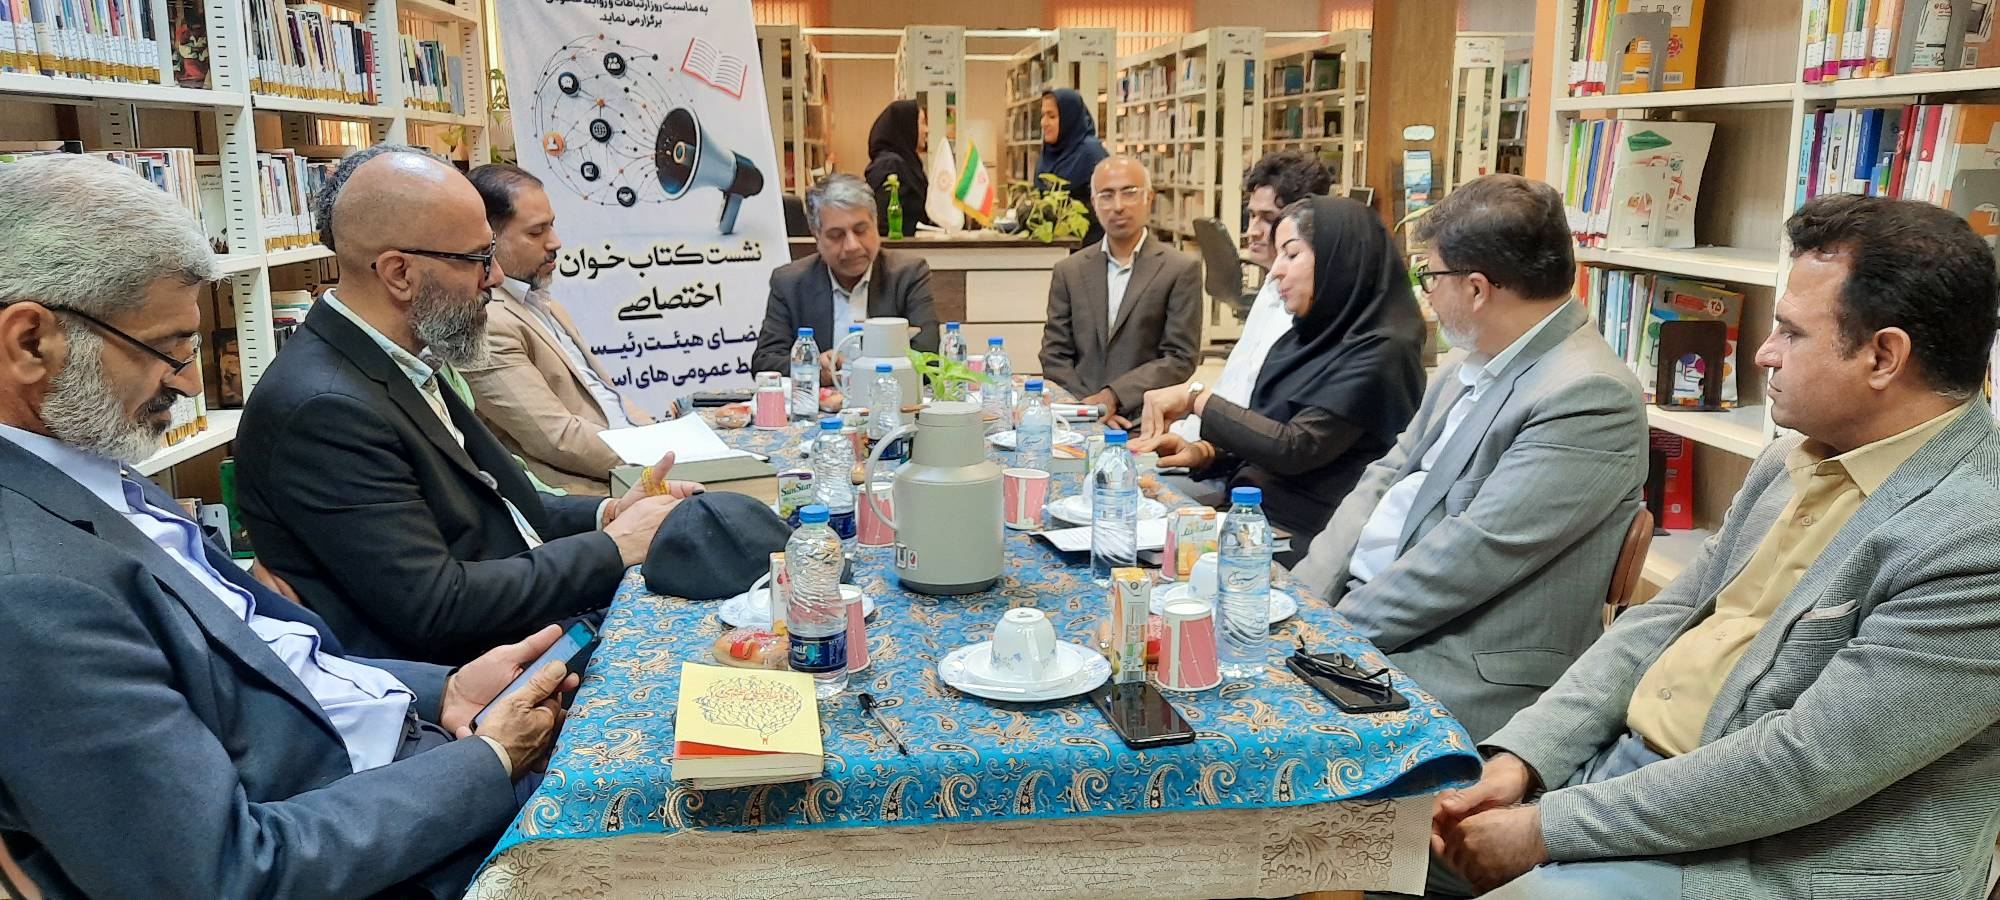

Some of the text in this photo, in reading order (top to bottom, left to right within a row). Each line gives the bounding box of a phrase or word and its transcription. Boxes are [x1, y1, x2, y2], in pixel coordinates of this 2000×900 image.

[663, 2, 699, 14] مناسبت
[559, 240, 762, 280] نشست کتاب خوان
[618, 282, 722, 321] اختصاصی
[644, 330, 704, 354] هیئت
[707, 325, 759, 350] ضای
[635, 364, 669, 389] های
[672, 361, 732, 386] عمومی
